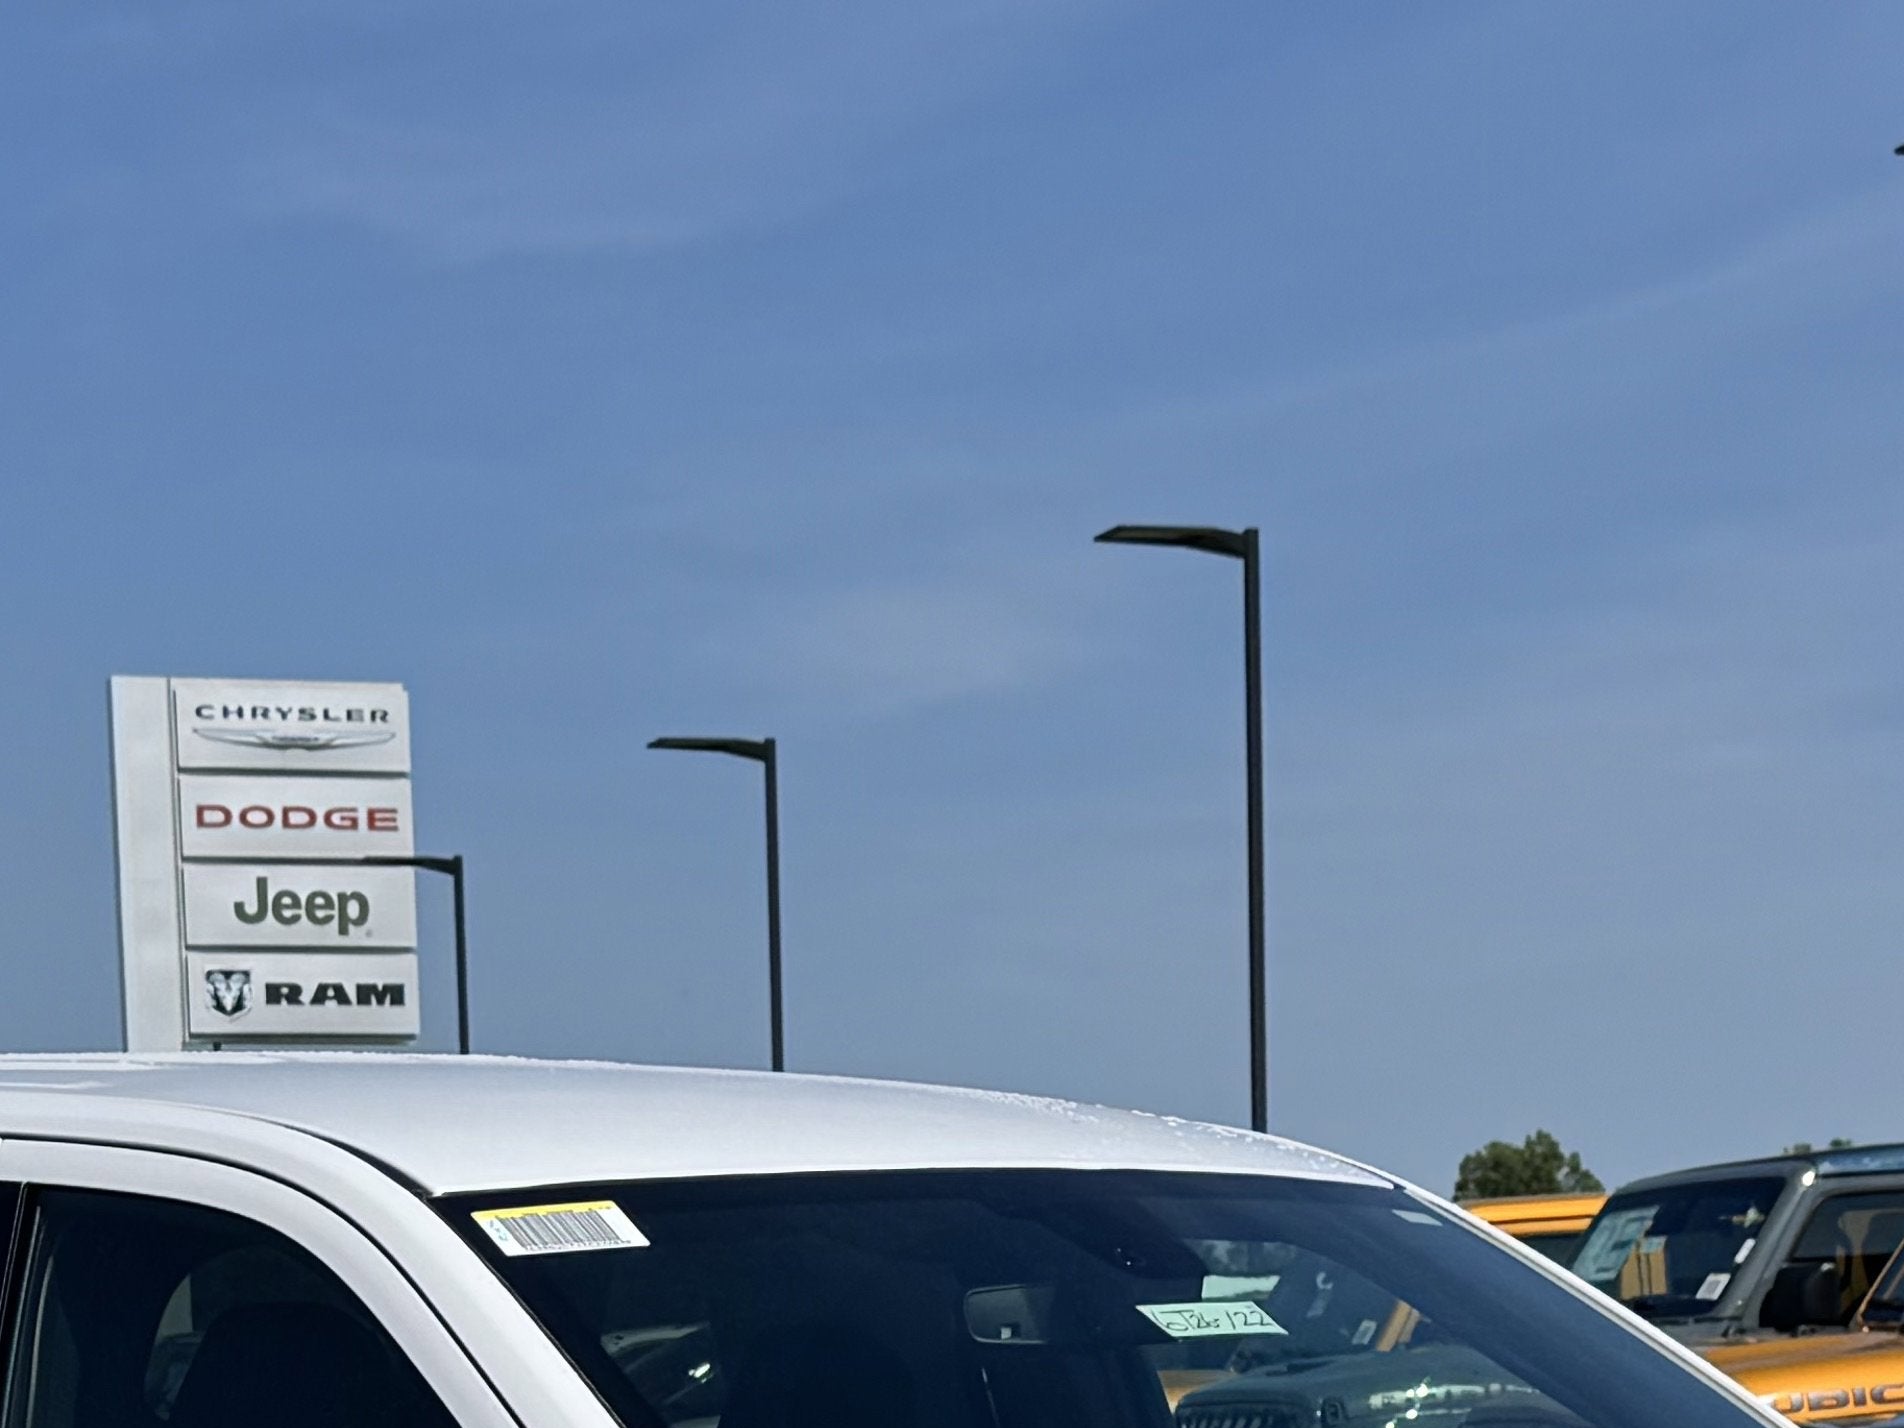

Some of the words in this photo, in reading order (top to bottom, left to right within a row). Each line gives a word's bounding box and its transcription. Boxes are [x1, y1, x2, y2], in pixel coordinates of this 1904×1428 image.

[195, 704, 390, 723] CHRYSLER
[196, 804, 400, 832] DODGE
[233, 876, 370, 936] Jeep
[265, 982, 406, 1006] RAM
